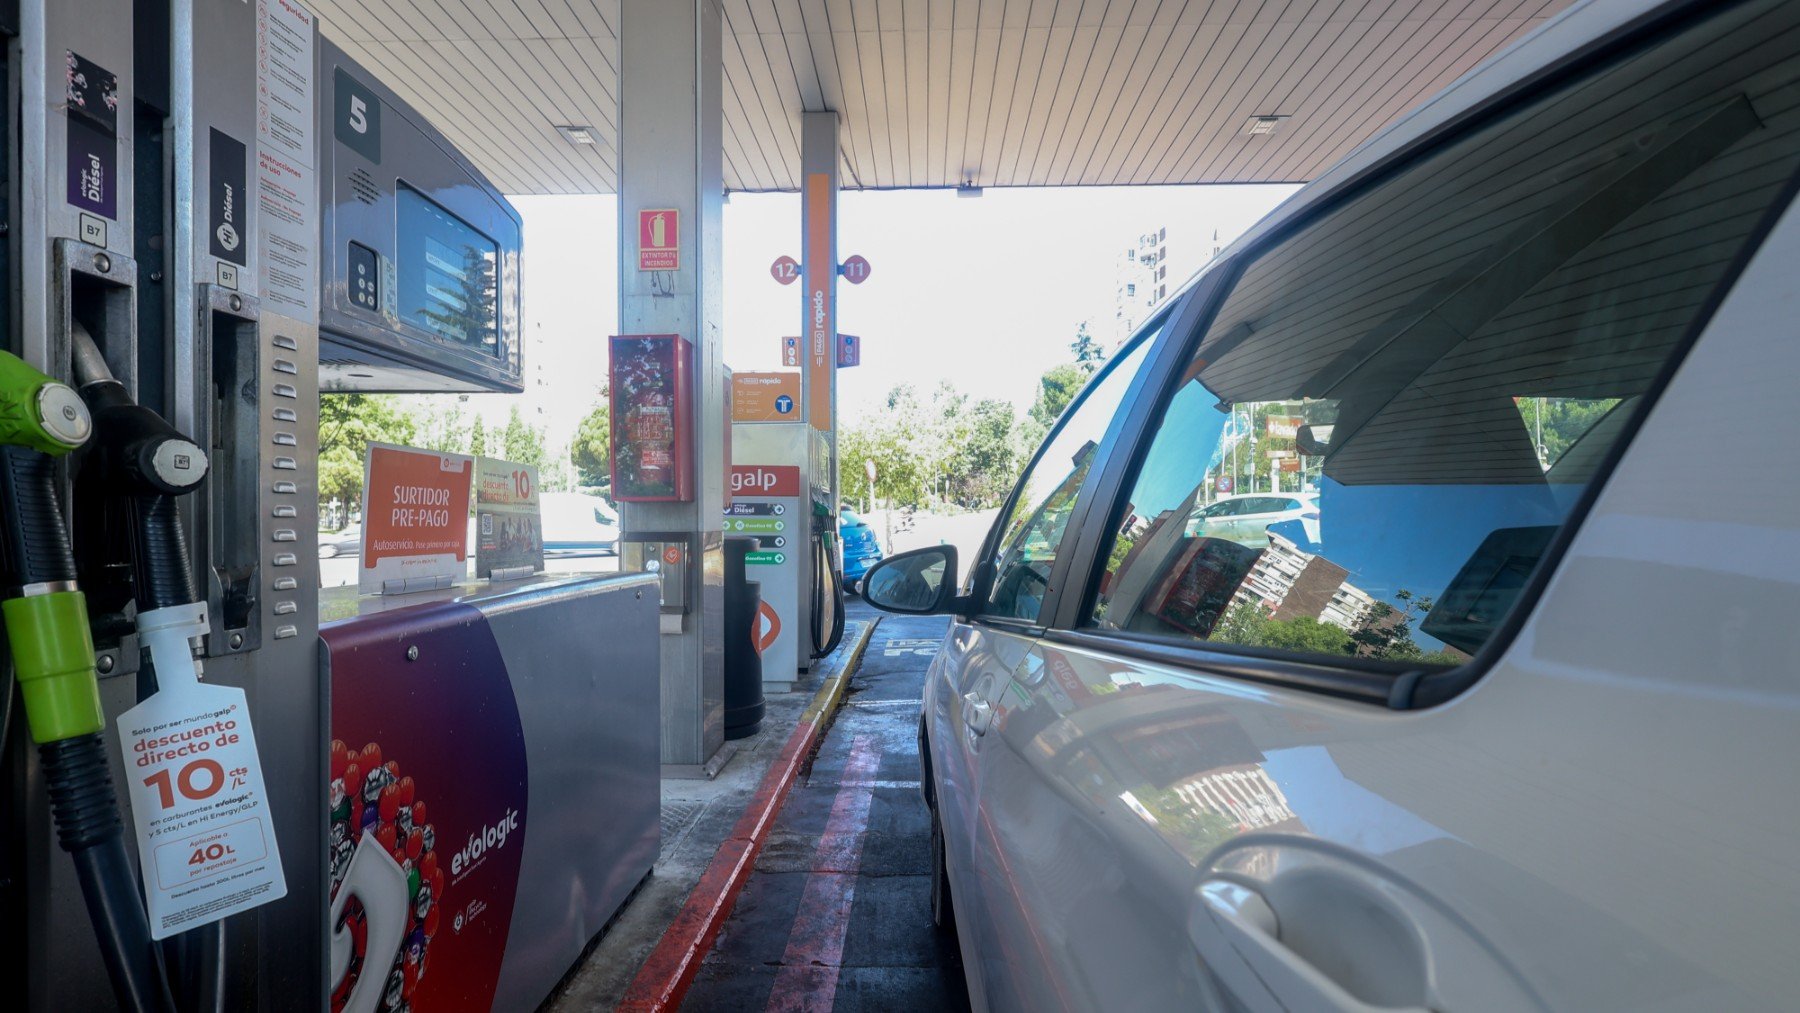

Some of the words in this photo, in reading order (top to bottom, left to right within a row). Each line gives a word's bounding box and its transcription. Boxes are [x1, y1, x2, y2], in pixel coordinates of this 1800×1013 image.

[349, 94, 367, 134] 5
[260, 150, 302, 178] Instrucciones
[260, 160, 268, 169] de
[269, 166, 281, 176] uso
[88, 153, 100, 203] Diésel
[224, 182, 233, 222] Diésel
[87, 225, 100, 236] B7
[222, 228, 232, 245] Hi
[222, 271, 233, 281] B7
[776, 263, 795, 277] 12
[847, 262, 864, 276] 11
[483, 478, 509, 490] descuento
[512, 470, 530, 499] 10
[731, 468, 777, 491] galp
[393, 485, 450, 506] SURTIDOR
[392, 508, 449, 527] PRE-PAGO
[373, 538, 415, 550] Autoservicio.
[132, 728, 151, 736] Solo
[153, 724, 167, 733] por
[134, 720, 236, 753] descuento
[136, 741, 210, 767] directo
[215, 733, 239, 747] de
[143, 759, 225, 809] 10
[232, 777, 246, 790] /L
[163, 805, 213, 824] carburantes
[163, 822, 187, 834] cts/L
[200, 815, 209, 823] Hi
[210, 801, 258, 820] Energy/GLP
[189, 834, 221, 848] Aplicable
[451, 807, 518, 875] evologic
[204, 858, 237, 872] repostaje
